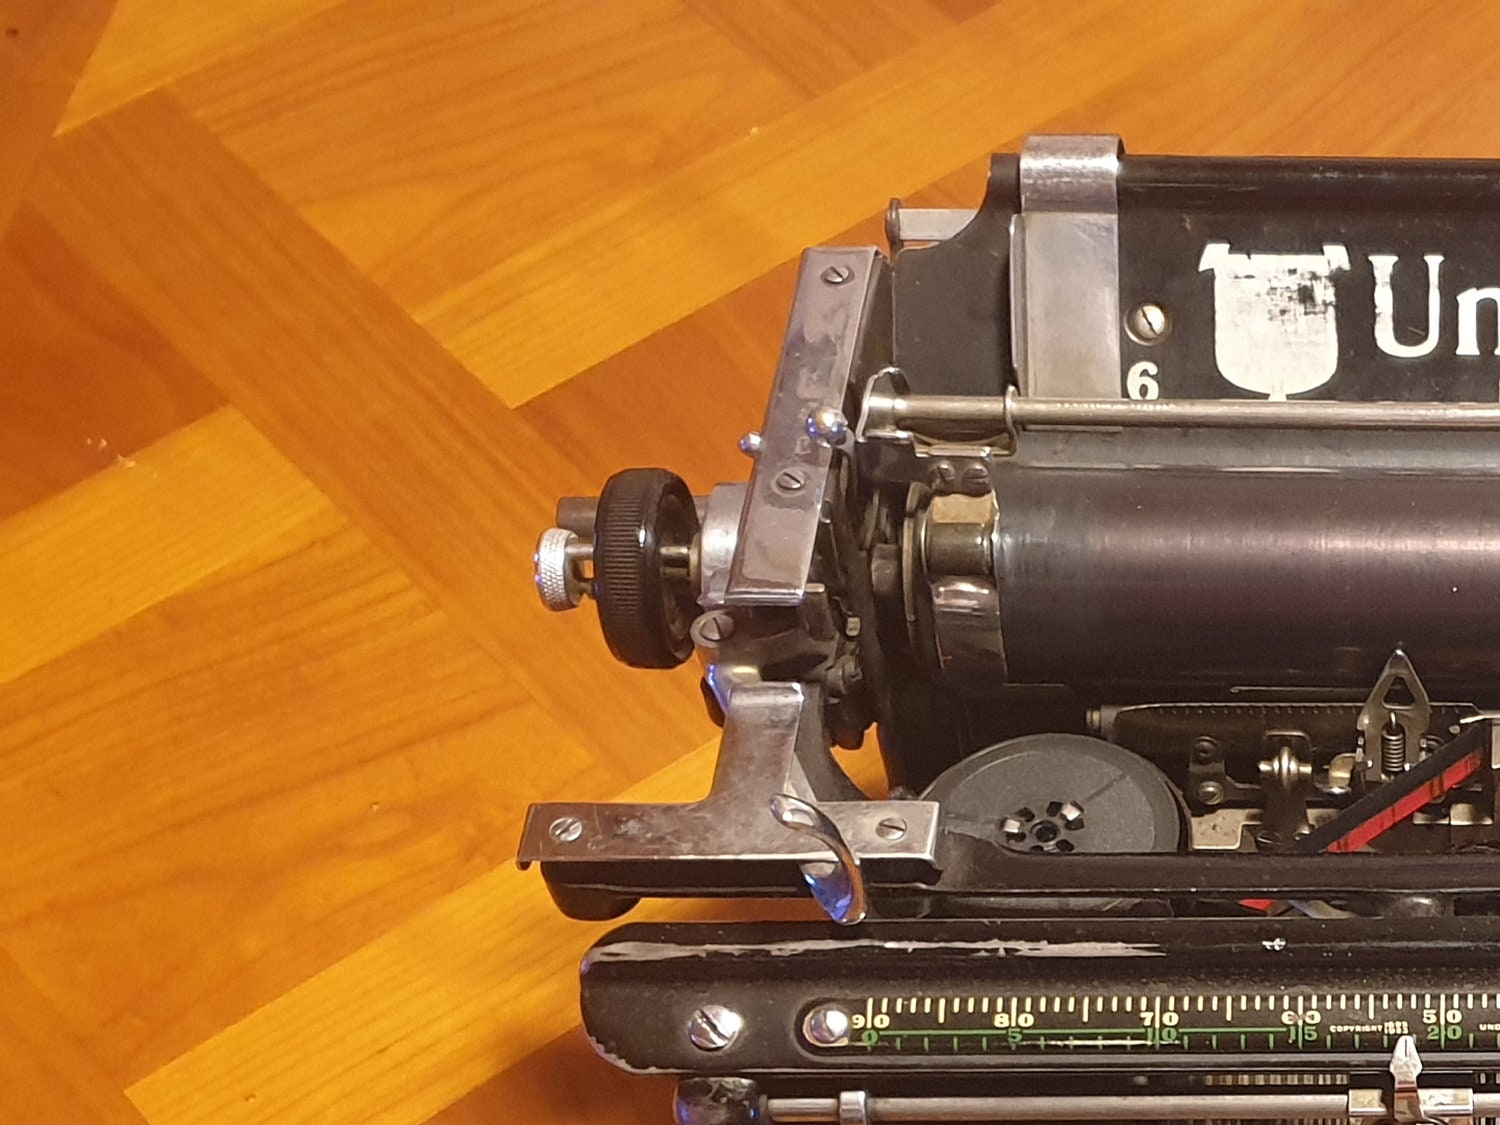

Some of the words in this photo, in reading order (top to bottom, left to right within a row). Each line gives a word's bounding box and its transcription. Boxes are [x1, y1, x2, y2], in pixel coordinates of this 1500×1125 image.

[1126, 360, 1159, 401] 6
[851, 1013, 891, 1029] 90
[993, 1013, 1035, 1029] 80
[1140, 1013, 1179, 1027] 70
[1423, 1011, 1463, 1025] 50
